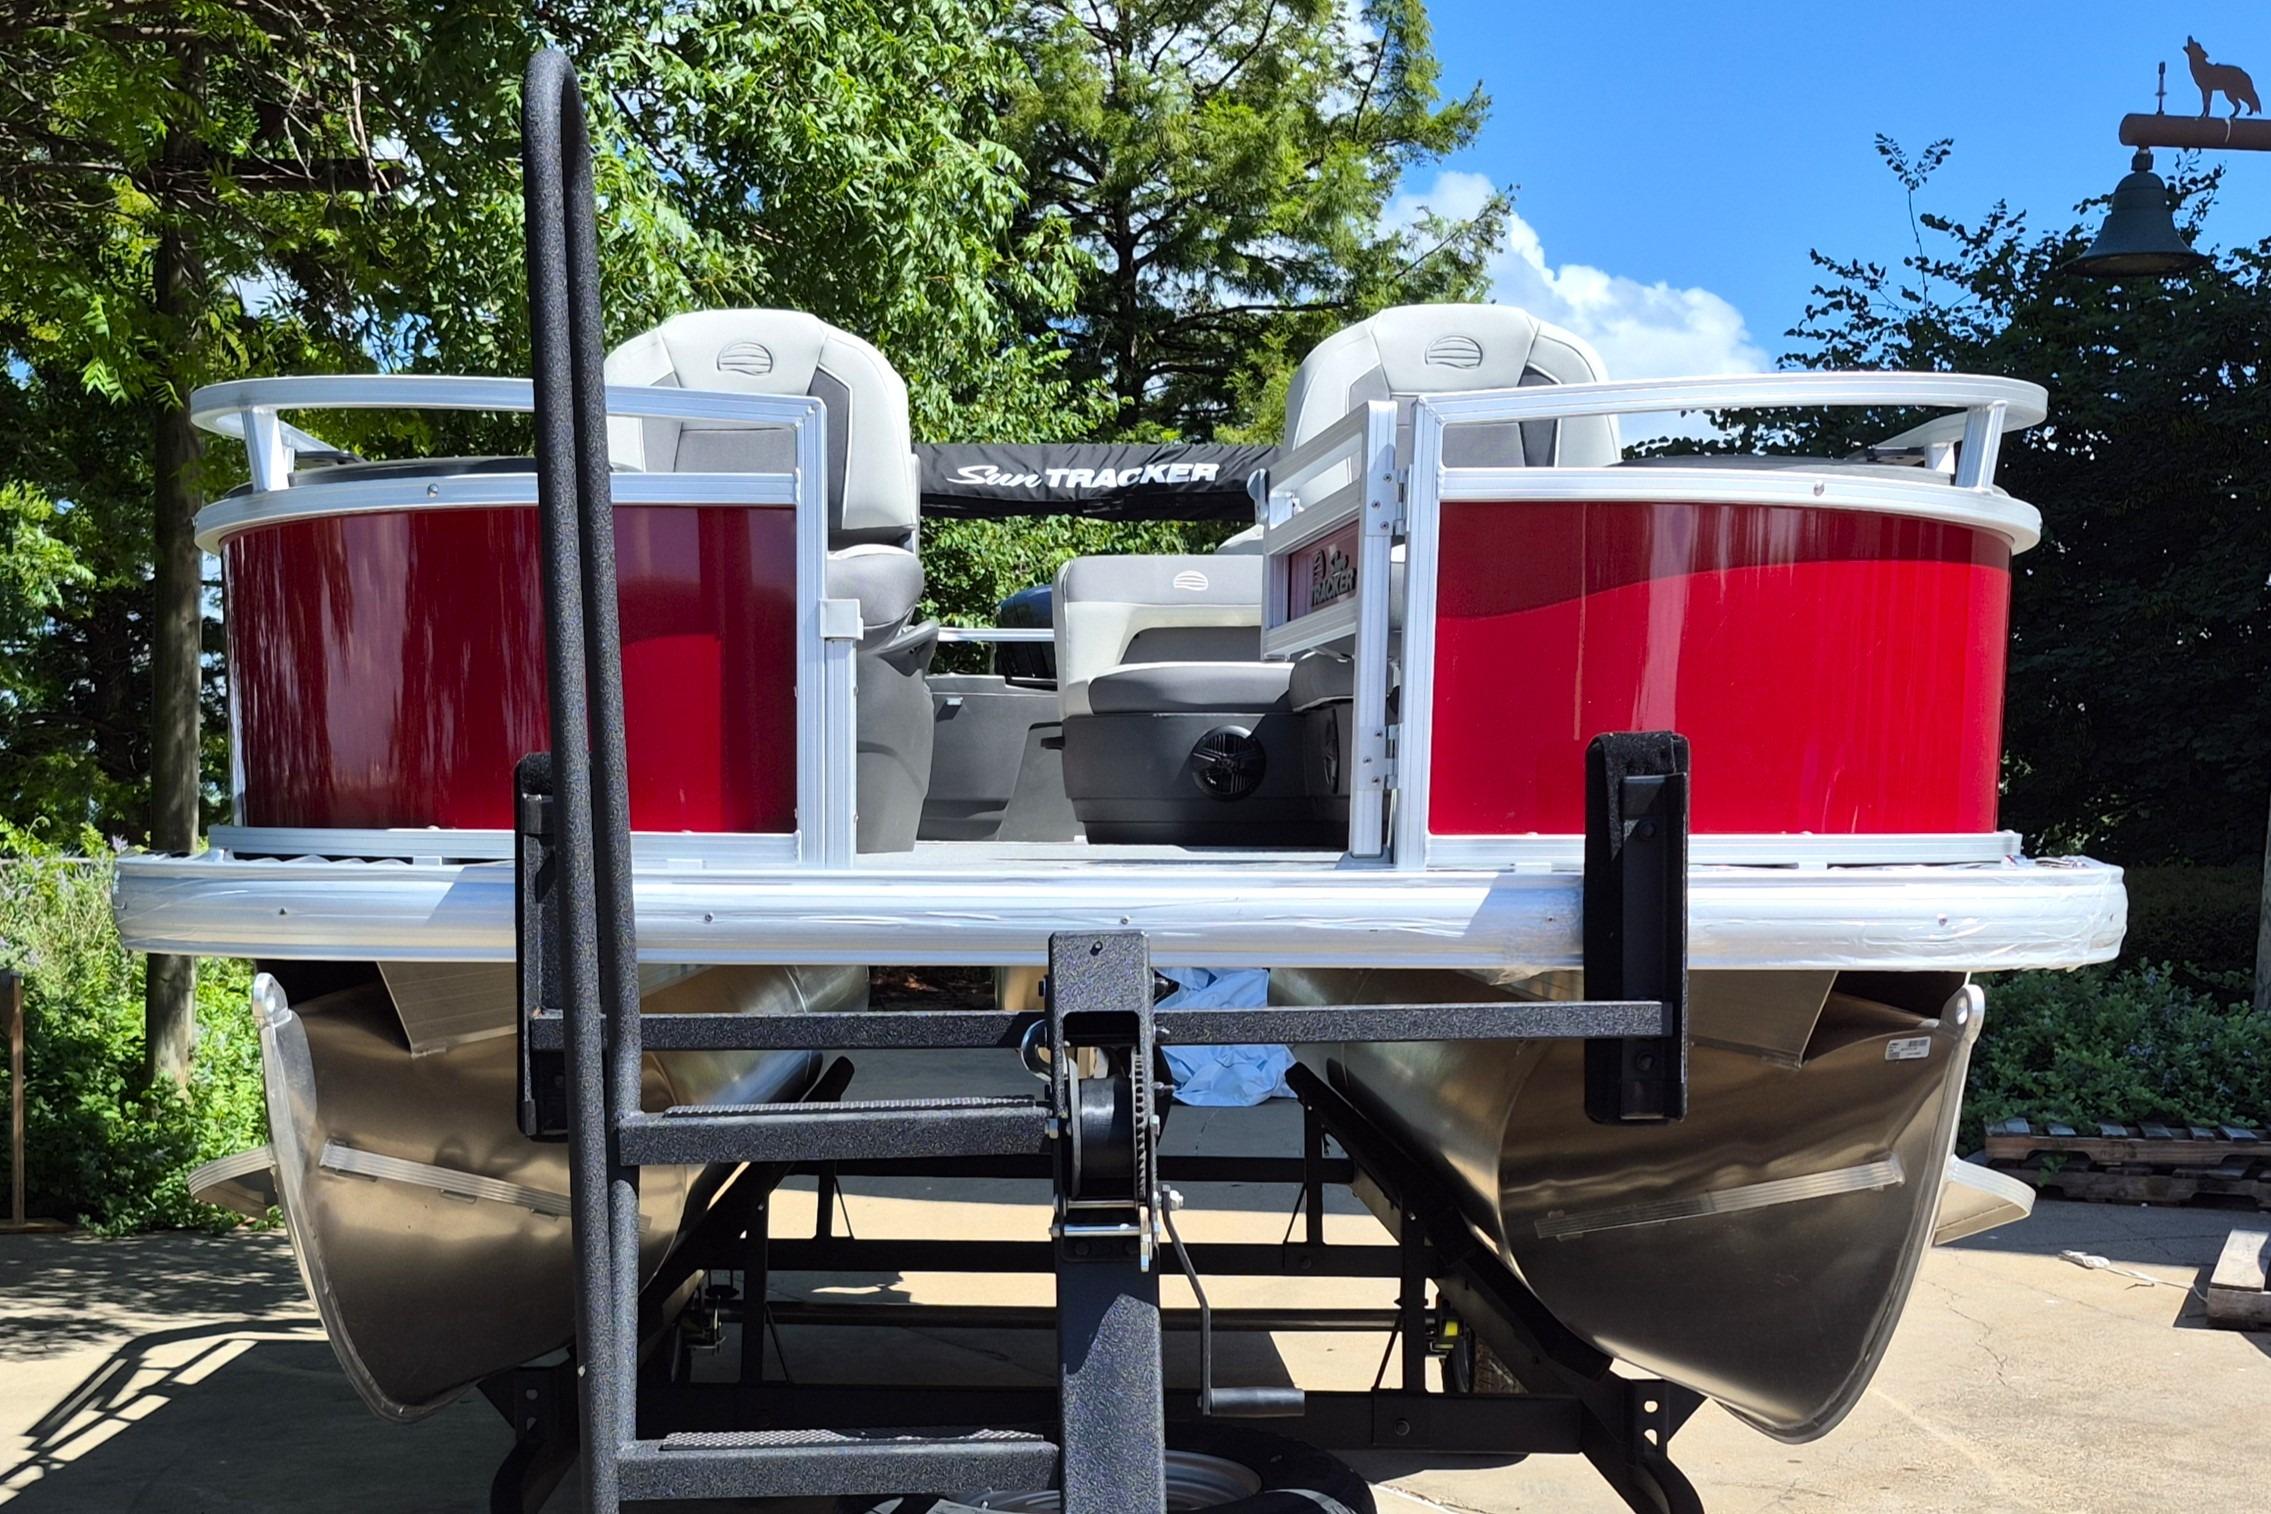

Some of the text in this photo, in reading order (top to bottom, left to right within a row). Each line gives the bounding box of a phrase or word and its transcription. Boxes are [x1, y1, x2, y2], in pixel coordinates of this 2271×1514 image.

[946, 463, 1220, 488] Sun TRACKER
[1311, 568, 1357, 607] TRACKER
